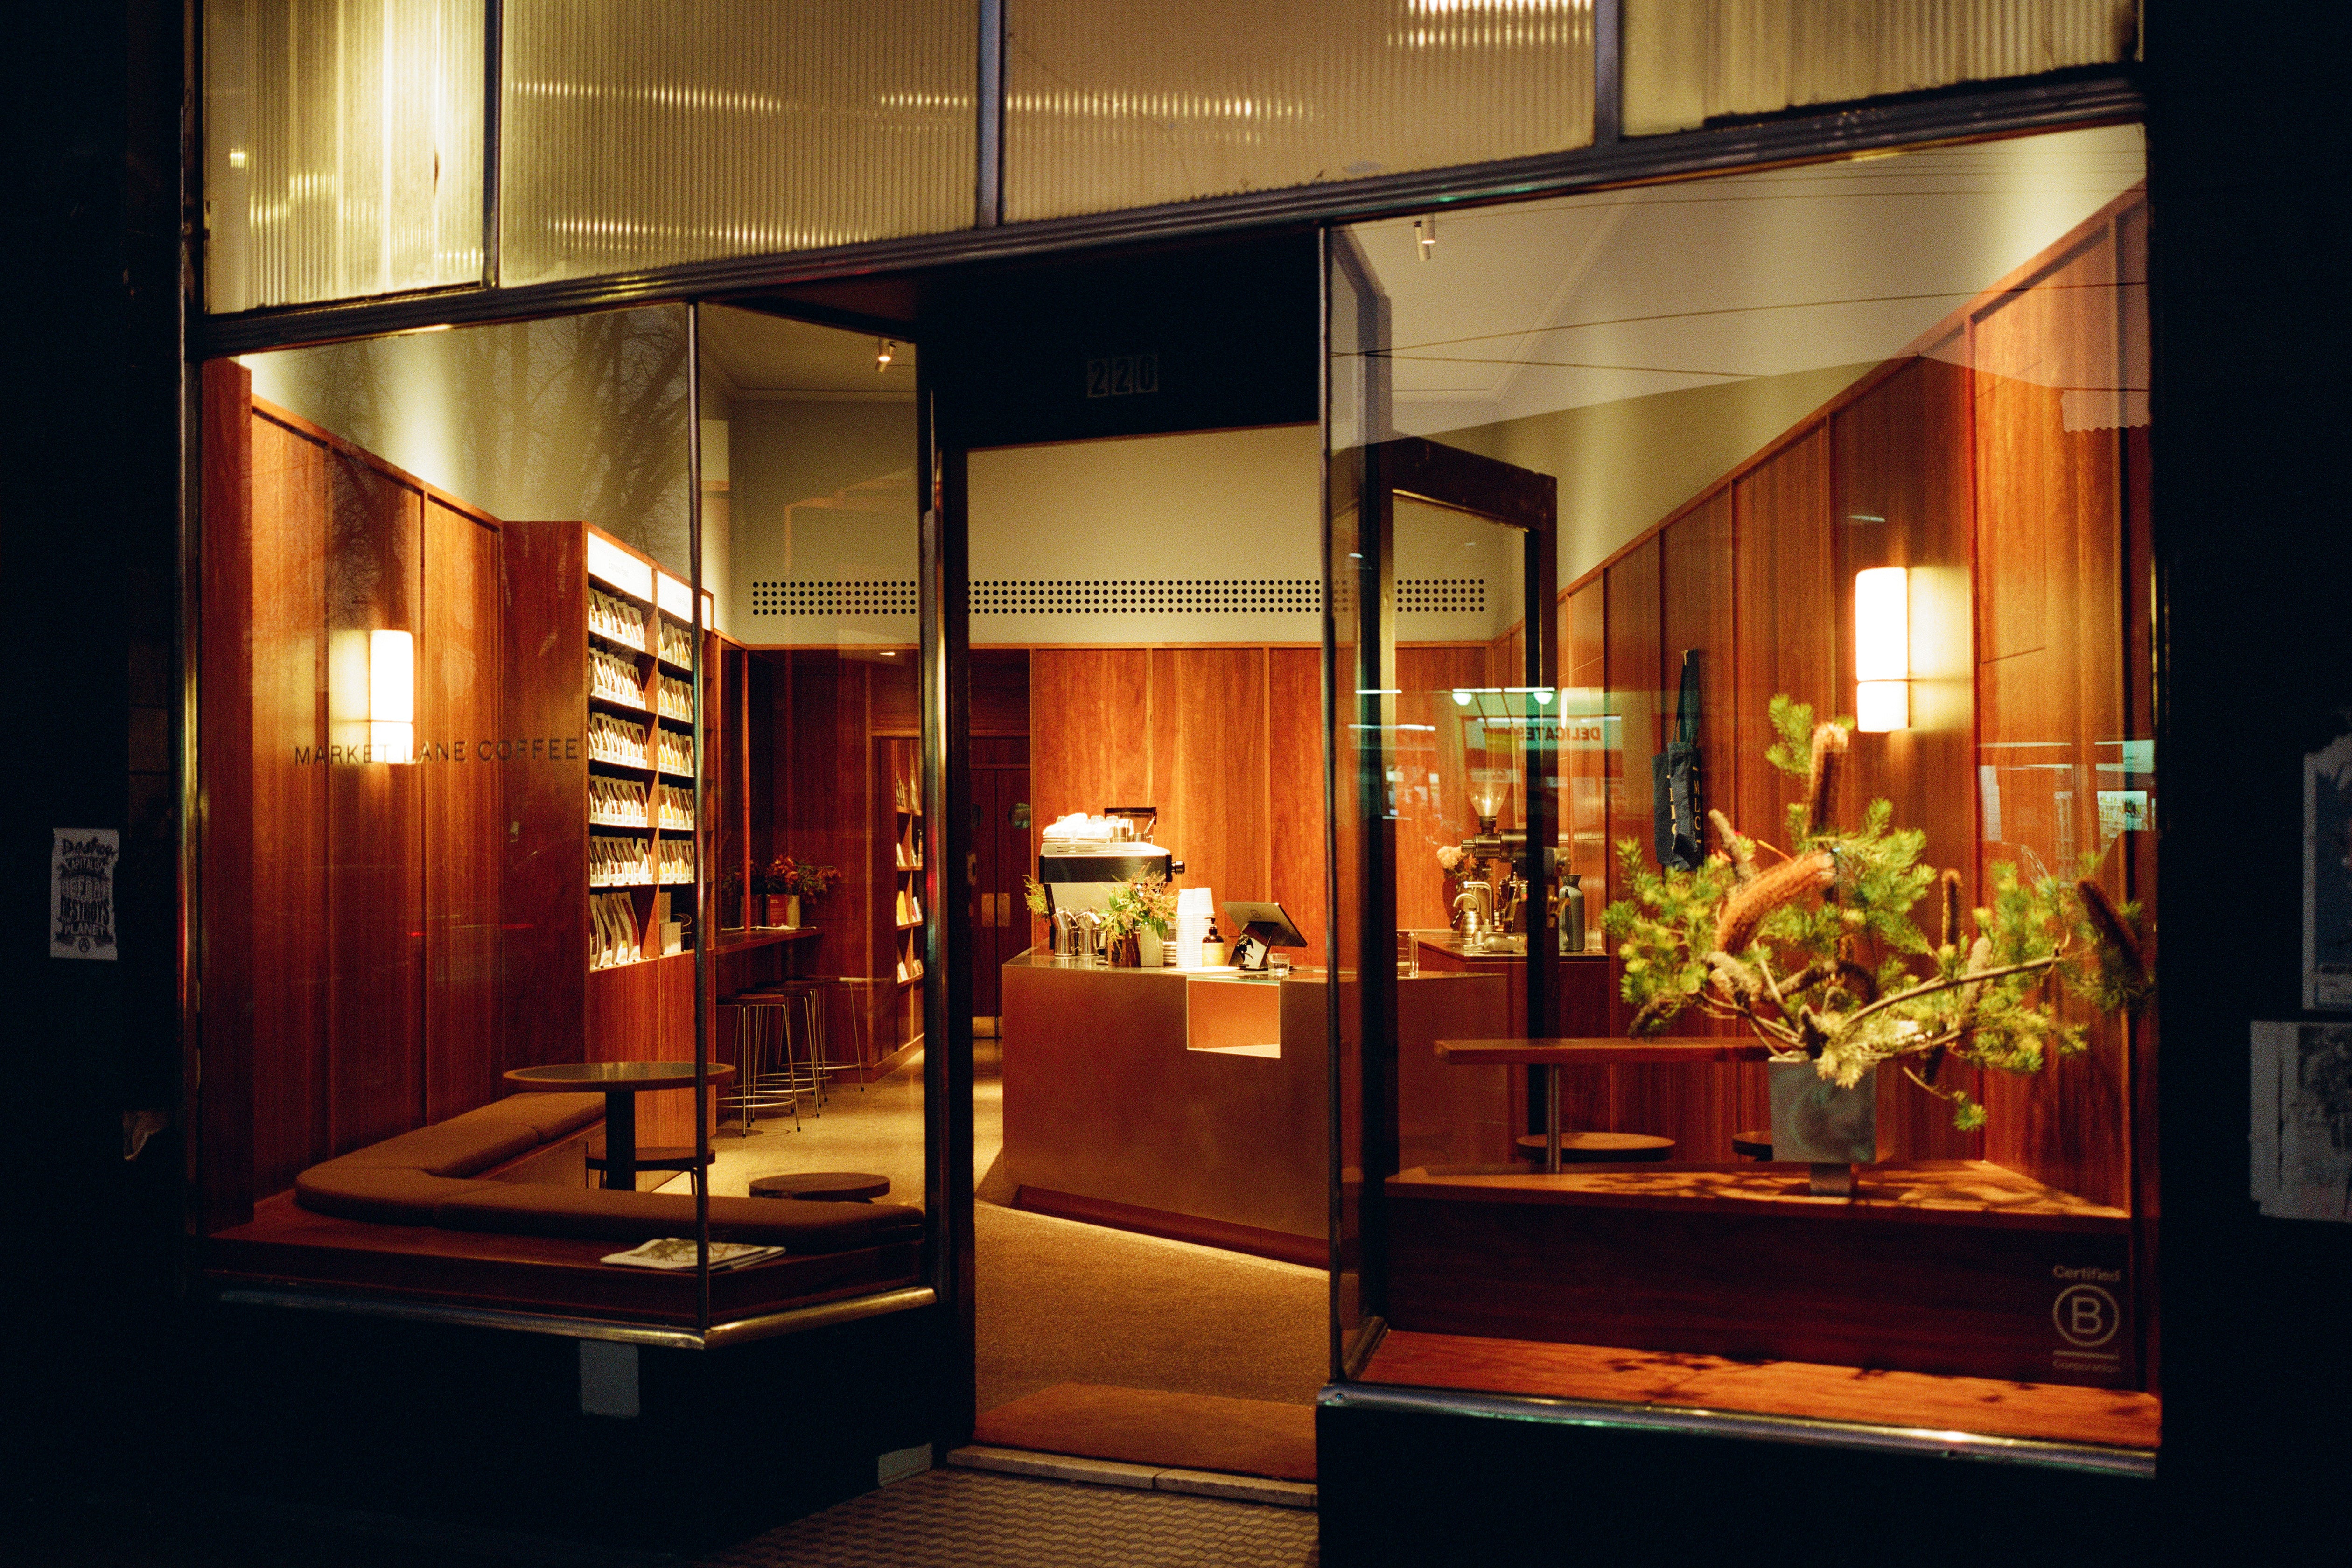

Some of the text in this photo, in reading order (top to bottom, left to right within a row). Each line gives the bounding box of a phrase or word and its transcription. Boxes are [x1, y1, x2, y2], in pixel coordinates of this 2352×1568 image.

[1090, 356, 1155, 395] 220
[295, 738, 578, 765] MARKET LANE COFFEE
[64, 921, 106, 936] PLANET
[2053, 1265, 2121, 1282] Certified
[2072, 1296, 2103, 1335] B
